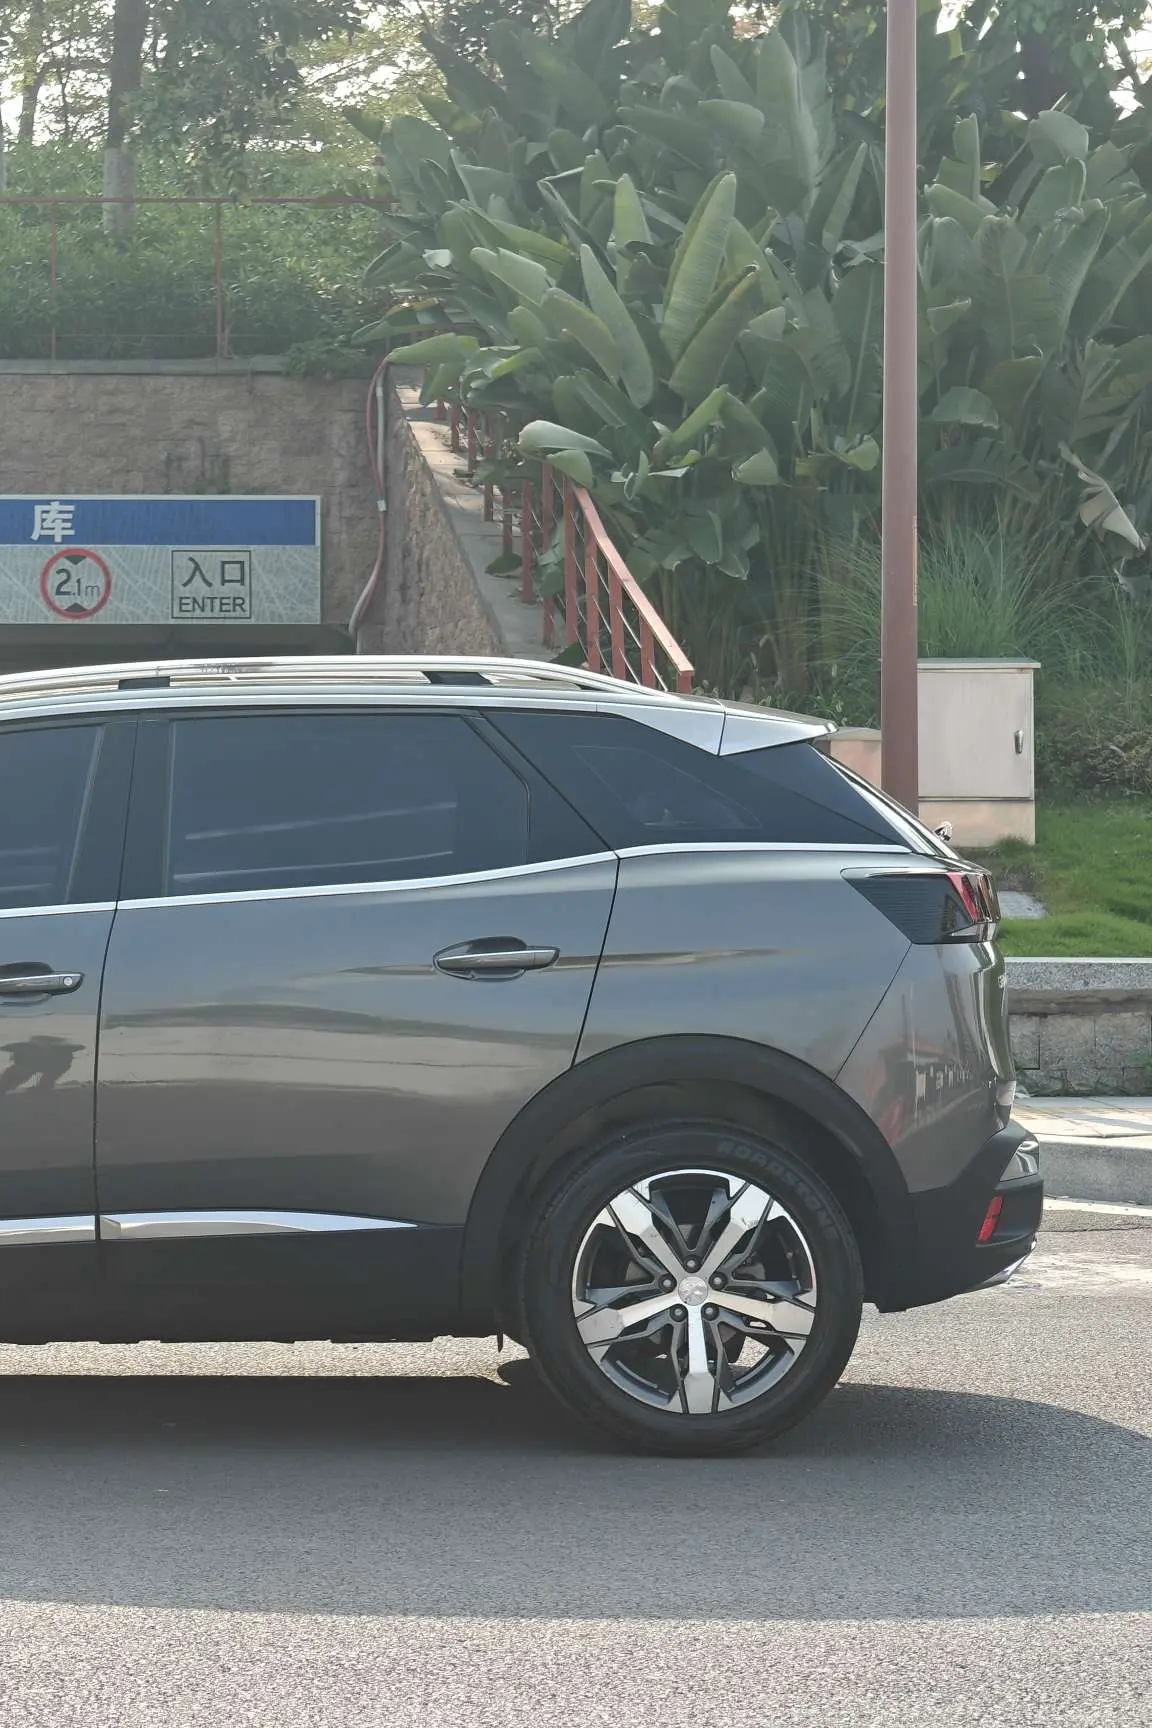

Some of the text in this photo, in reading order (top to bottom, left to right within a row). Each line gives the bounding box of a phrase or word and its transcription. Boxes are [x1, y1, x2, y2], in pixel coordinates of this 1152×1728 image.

[54, 568, 101, 598] 2.1m
[182, 556, 246, 588] 入口
[180, 597, 246, 614] ENTER
